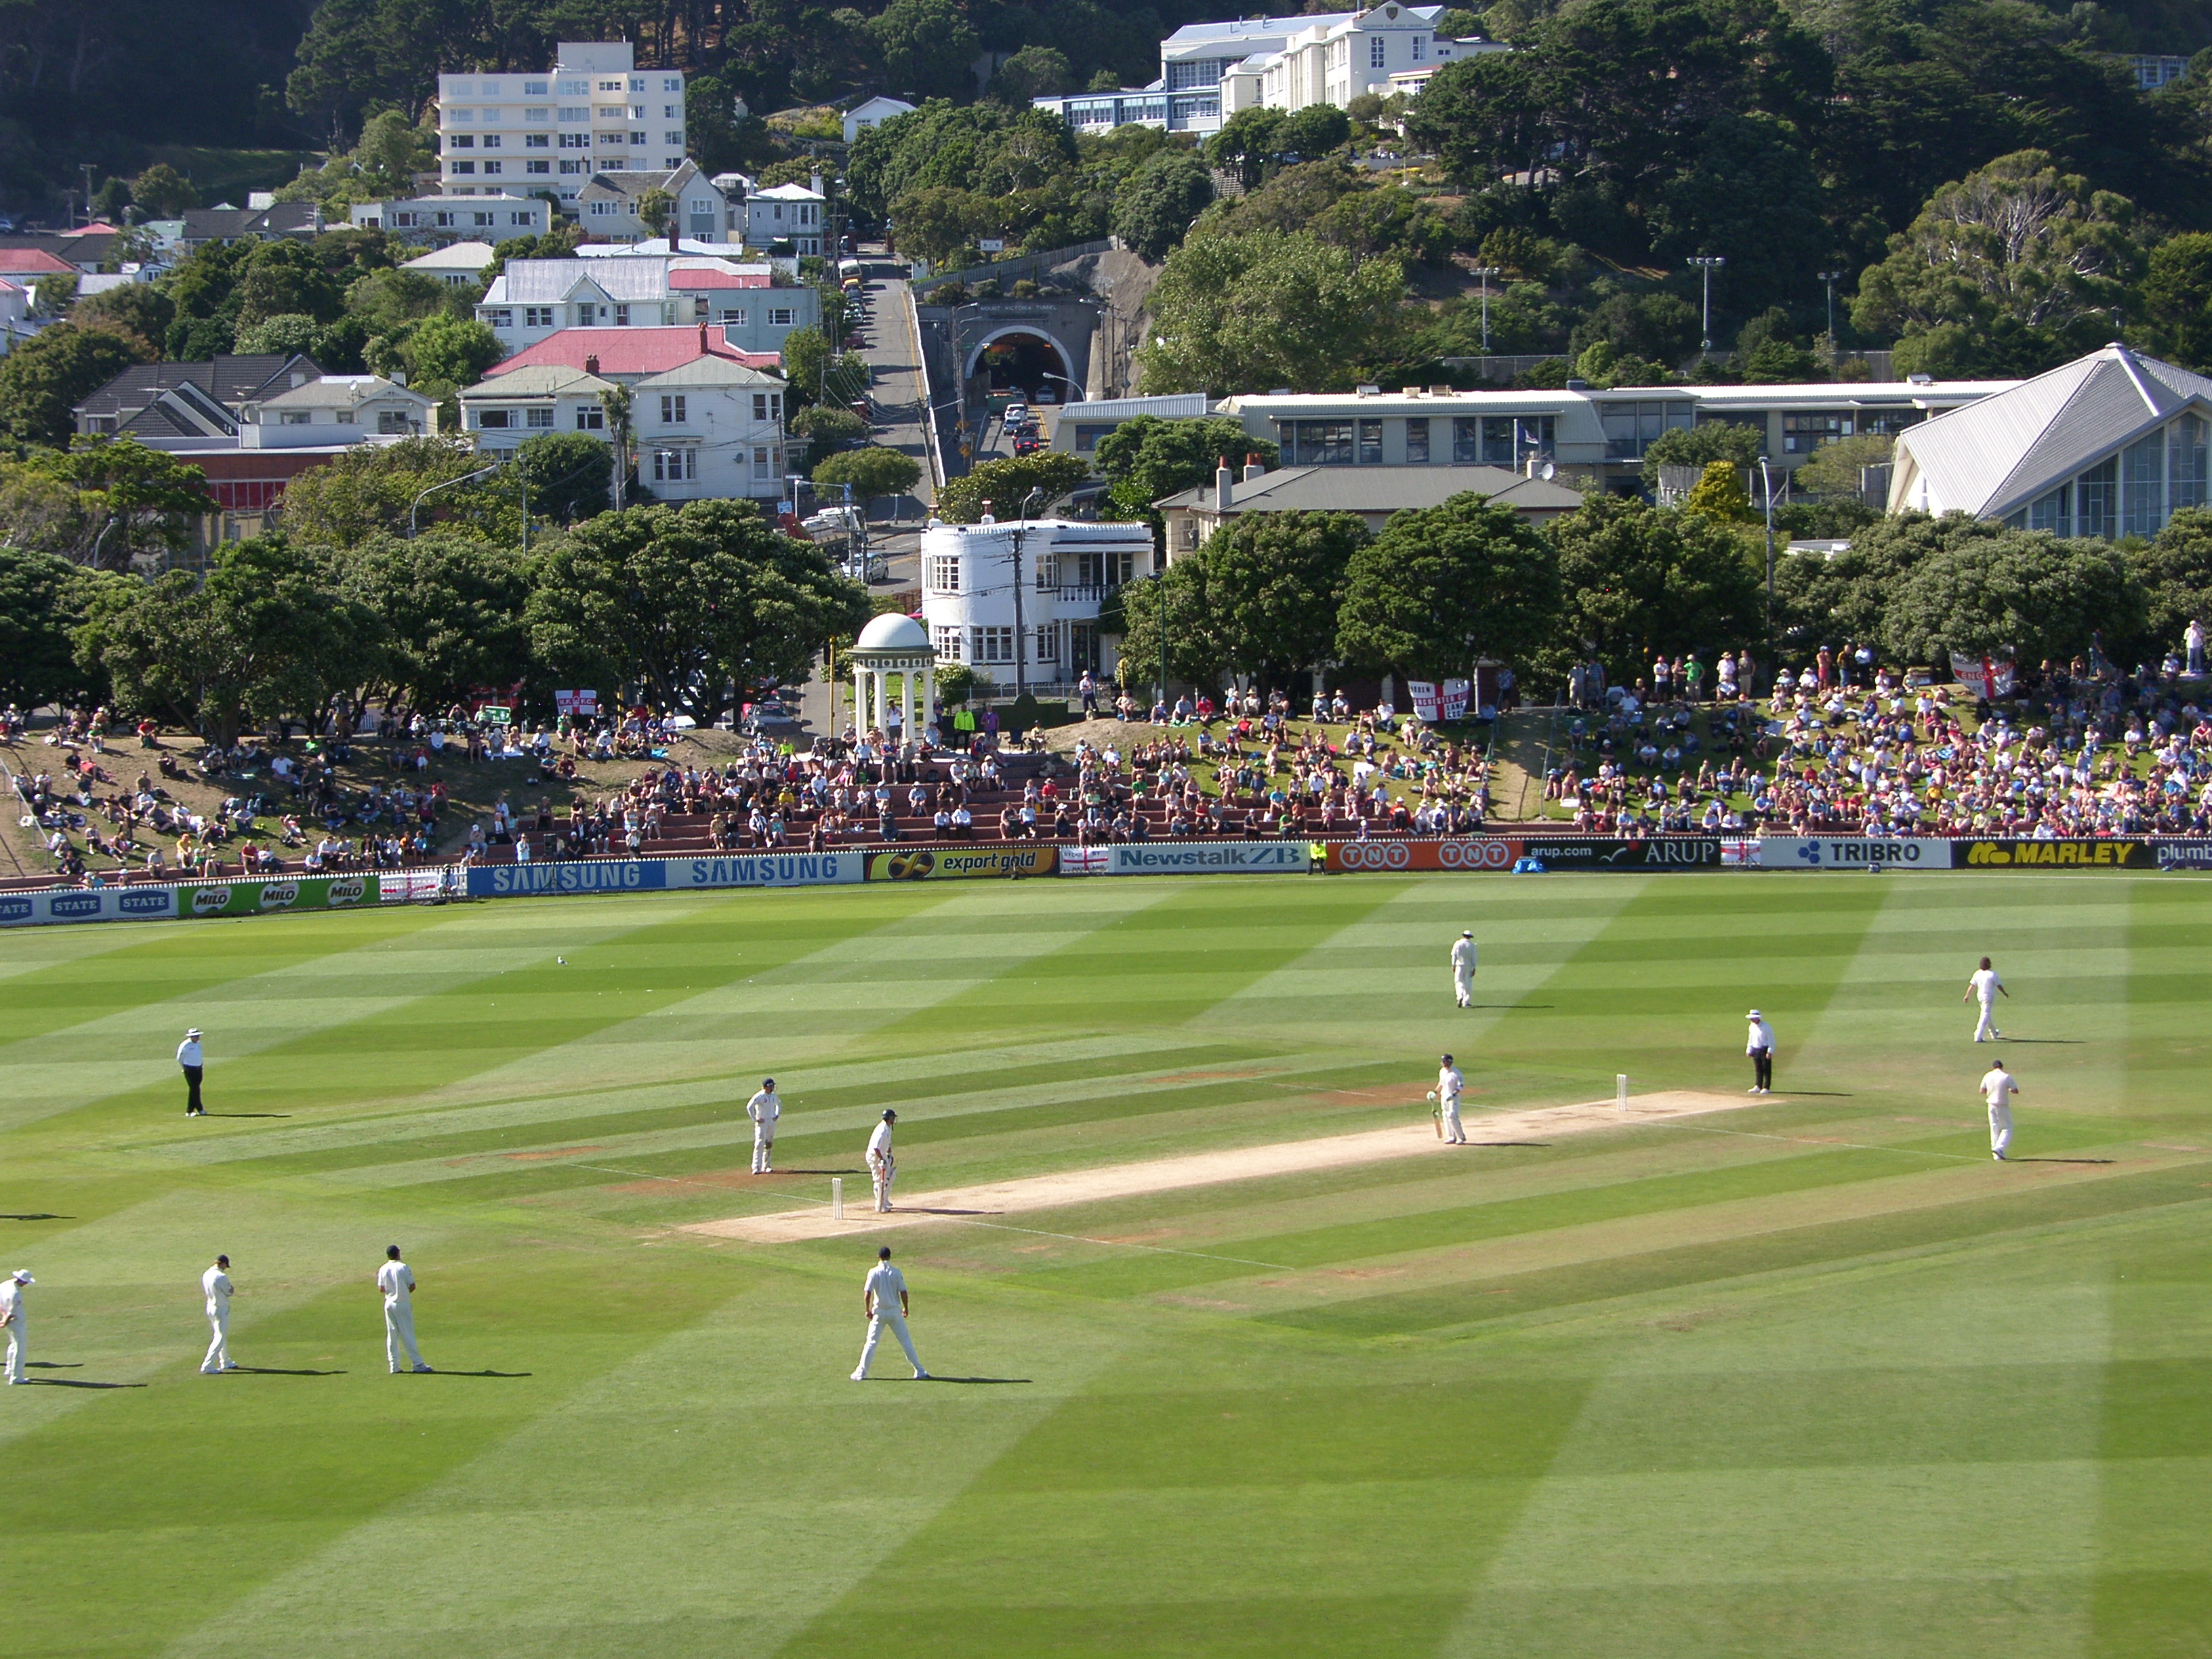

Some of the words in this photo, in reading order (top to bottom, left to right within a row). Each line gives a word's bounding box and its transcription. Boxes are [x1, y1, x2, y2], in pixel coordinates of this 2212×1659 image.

[1414, 695, 1454, 705] NCHESTER
[1120, 848, 1247, 865] Newstalk
[1248, 848, 1300, 864] ZB
[1531, 848, 1592, 857] arup.com
[1645, 842, 1714, 862] ARUP
[1830, 843, 1920, 861] TRIBRO
[2014, 842, 2134, 863] MARLEY
[943, 853, 998, 873] export
[1000, 851, 1036, 872] gold
[692, 856, 838, 883] SAMSUNG
[493, 863, 640, 891] SAMSUNG
[263, 890, 295, 901] MILO
[330, 886, 363, 898] MILO
[54, 900, 97, 912] STATE
[123, 897, 165, 907] STATE
[195, 894, 228, 905] MILO
